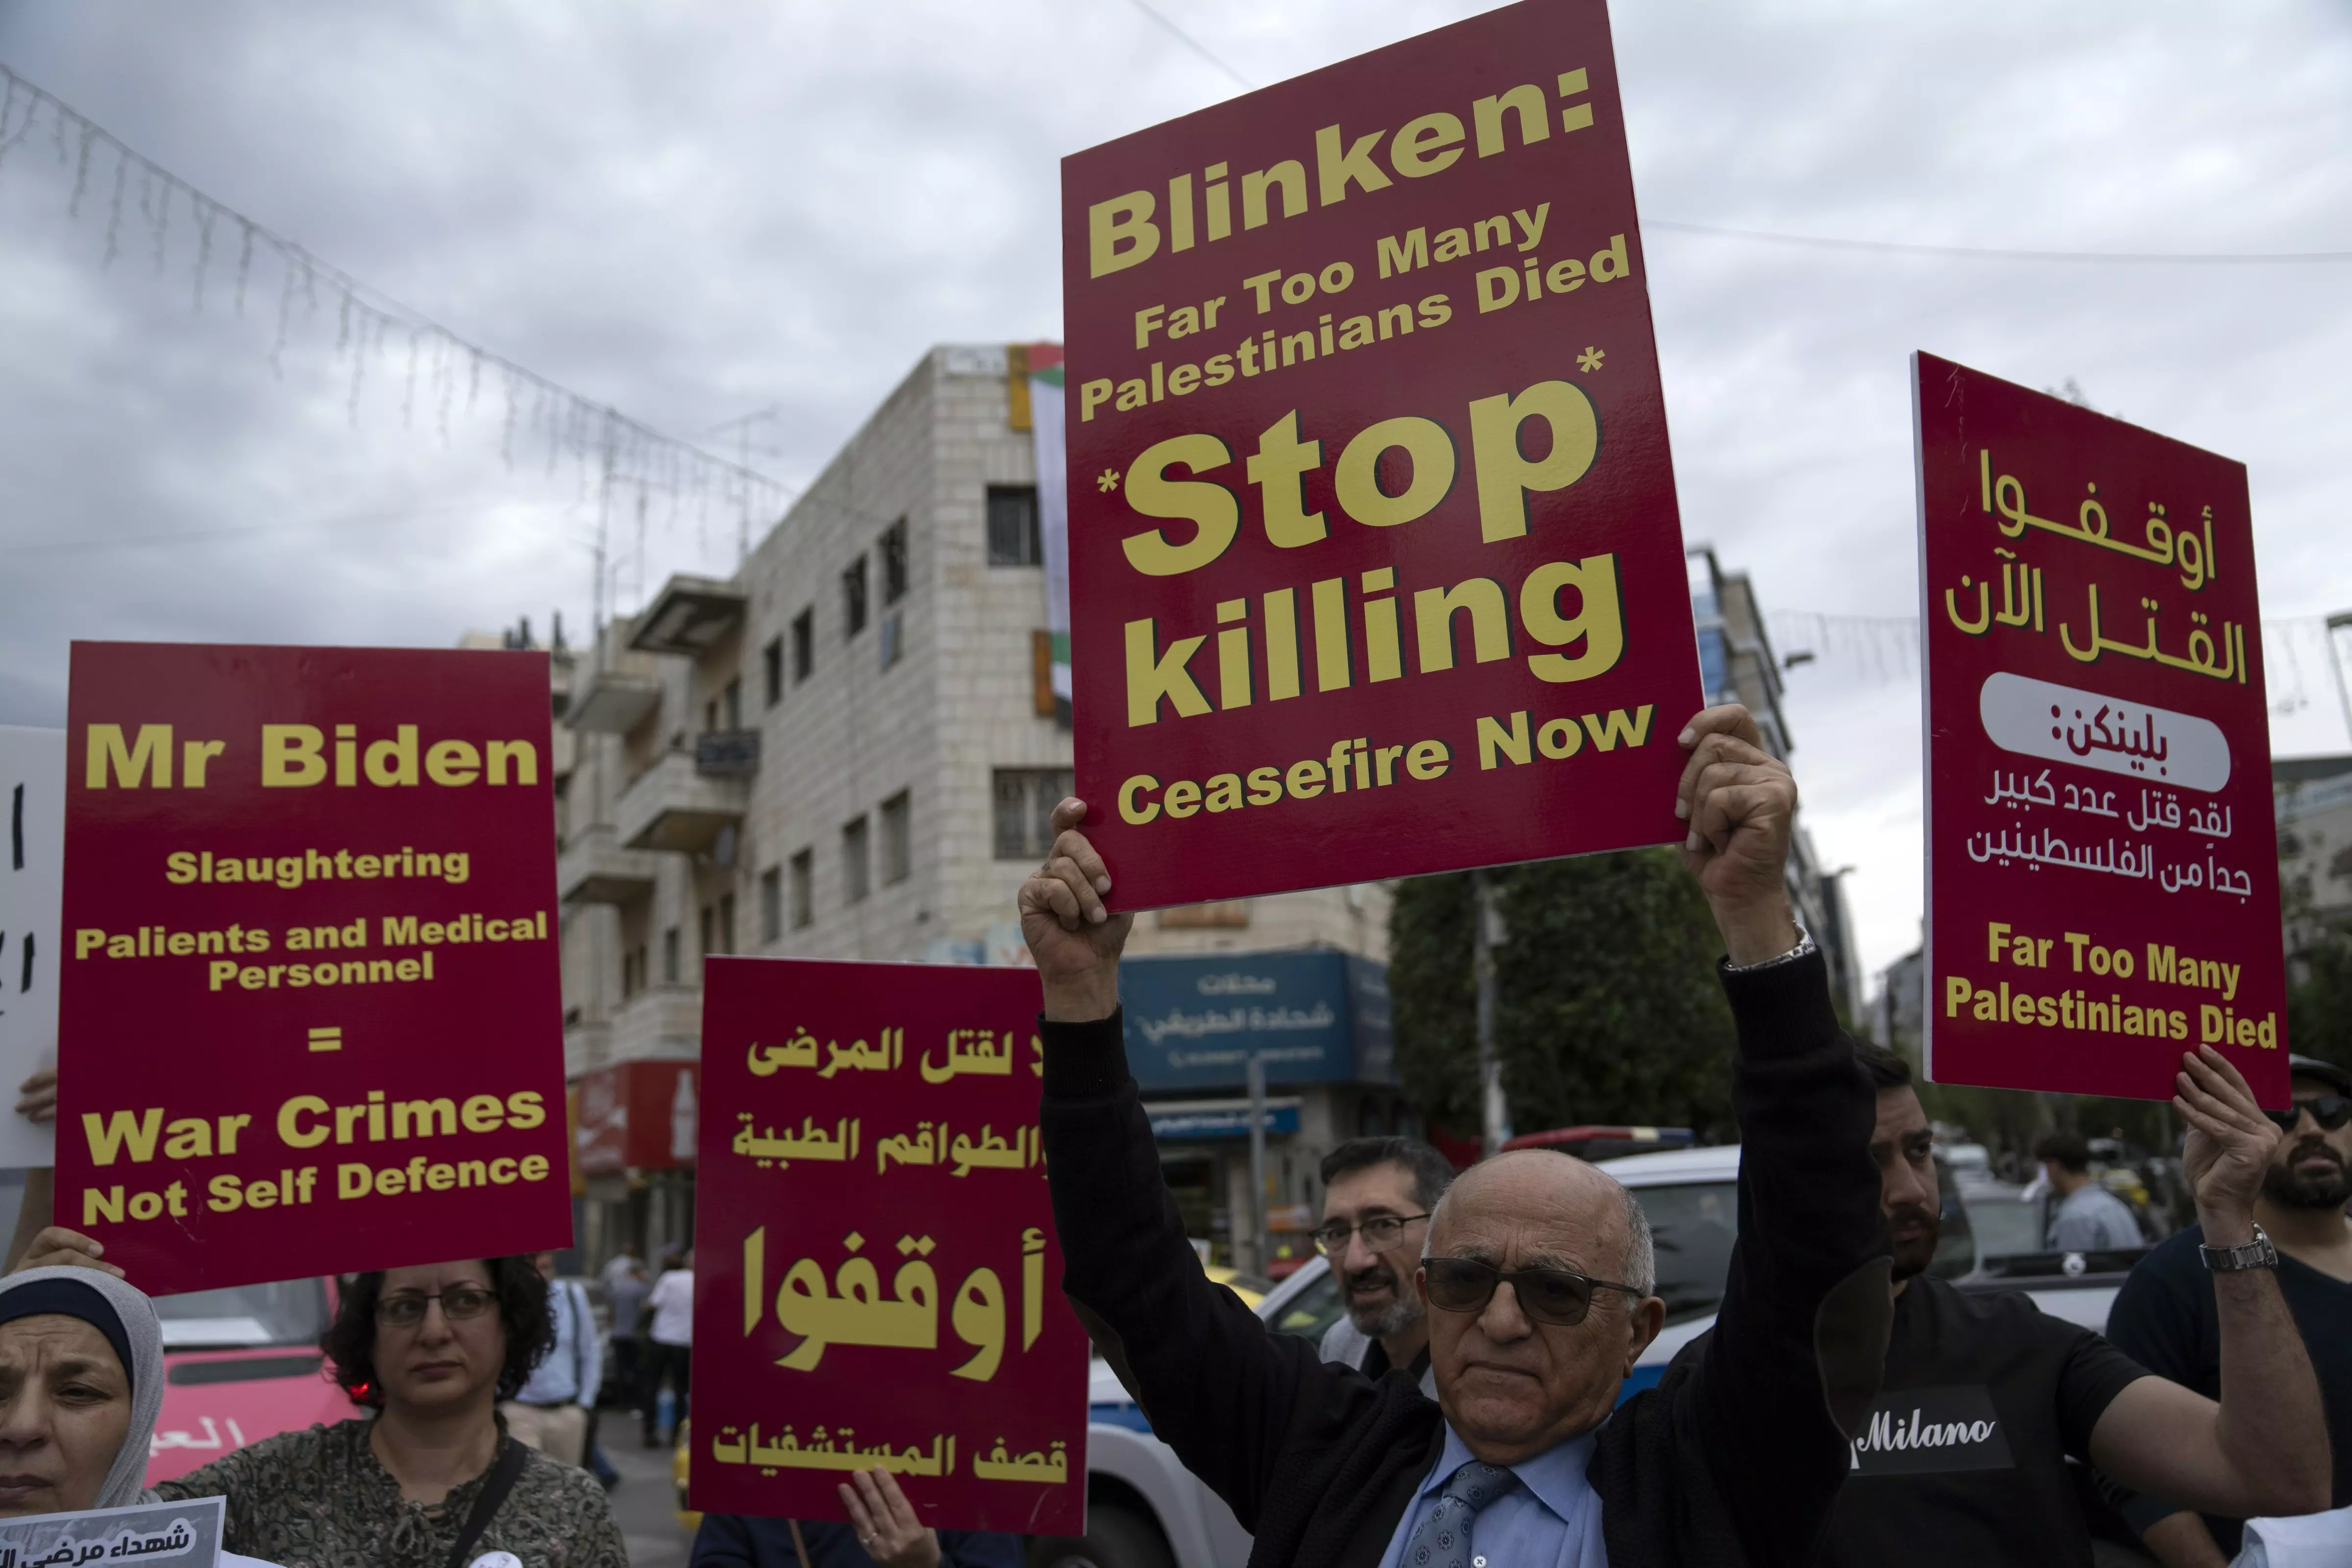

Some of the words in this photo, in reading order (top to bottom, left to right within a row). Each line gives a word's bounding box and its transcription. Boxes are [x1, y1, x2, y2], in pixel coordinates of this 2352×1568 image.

[1089, 69, 1592, 278] Blinken:
[1135, 297, 1225, 349] Far
[1243, 262, 1354, 314] Too
[1377, 203, 1549, 278] Many
[1081, 294, 1451, 421] Palestinians
[1476, 235, 1629, 314] Died
[1981, 450, 2215, 589] أوقفوا
[1946, 548, 2043, 634] الآن
[1125, 553, 1622, 727] killing
[2060, 584, 2246, 683] القتل
[86, 724, 225, 788] Mr
[262, 724, 537, 787] Biden
[1119, 738, 1448, 824] Ceasefire
[1477, 704, 1652, 770] Now
[2051, 704, 2167, 776] بلينكن:
[1985, 770, 2055, 810] كبير
[2064, 784, 2118, 817] عدد
[2128, 790, 2180, 831] قتل
[2189, 802, 2230, 837] لقد
[167, 847, 468, 888] Slaughtering
[1968, 822, 2153, 879] الفلسطينين
[2160, 862, 2203, 893] من
[76, 925, 269, 959] Palients
[287, 919, 366, 949] and
[383, 912, 546, 945] Medical
[1989, 922, 2053, 967] Far
[2065, 933, 2133, 977] Too
[2148, 944, 2240, 1000] Many
[210, 952, 433, 990] Personnel
[309, 1028, 341, 1051] =
[1947, 977, 2187, 1039] Palestinians
[2201, 1005, 2276, 1048] Died
[748, 1025, 904, 1078] المرضى
[920, 1029, 1013, 1084] لقتل
[82, 1109, 250, 1165] War
[278, 1091, 545, 1147] Crimes
[733, 1112, 860, 1169] الطبية
[877, 1121, 1048, 1180] الطواقم
[84, 1182, 187, 1225] Not
[208, 1167, 317, 1211] Self
[339, 1156, 548, 1199] Defence
[743, 1225, 1046, 1382] أوقفوا
[712, 1423, 956, 1476] المستشفيات
[1856, 1408, 1997, 1452] Milano
[973, 1436, 1067, 1483] قصف
[111, 1525, 189, 1558] شهداء
